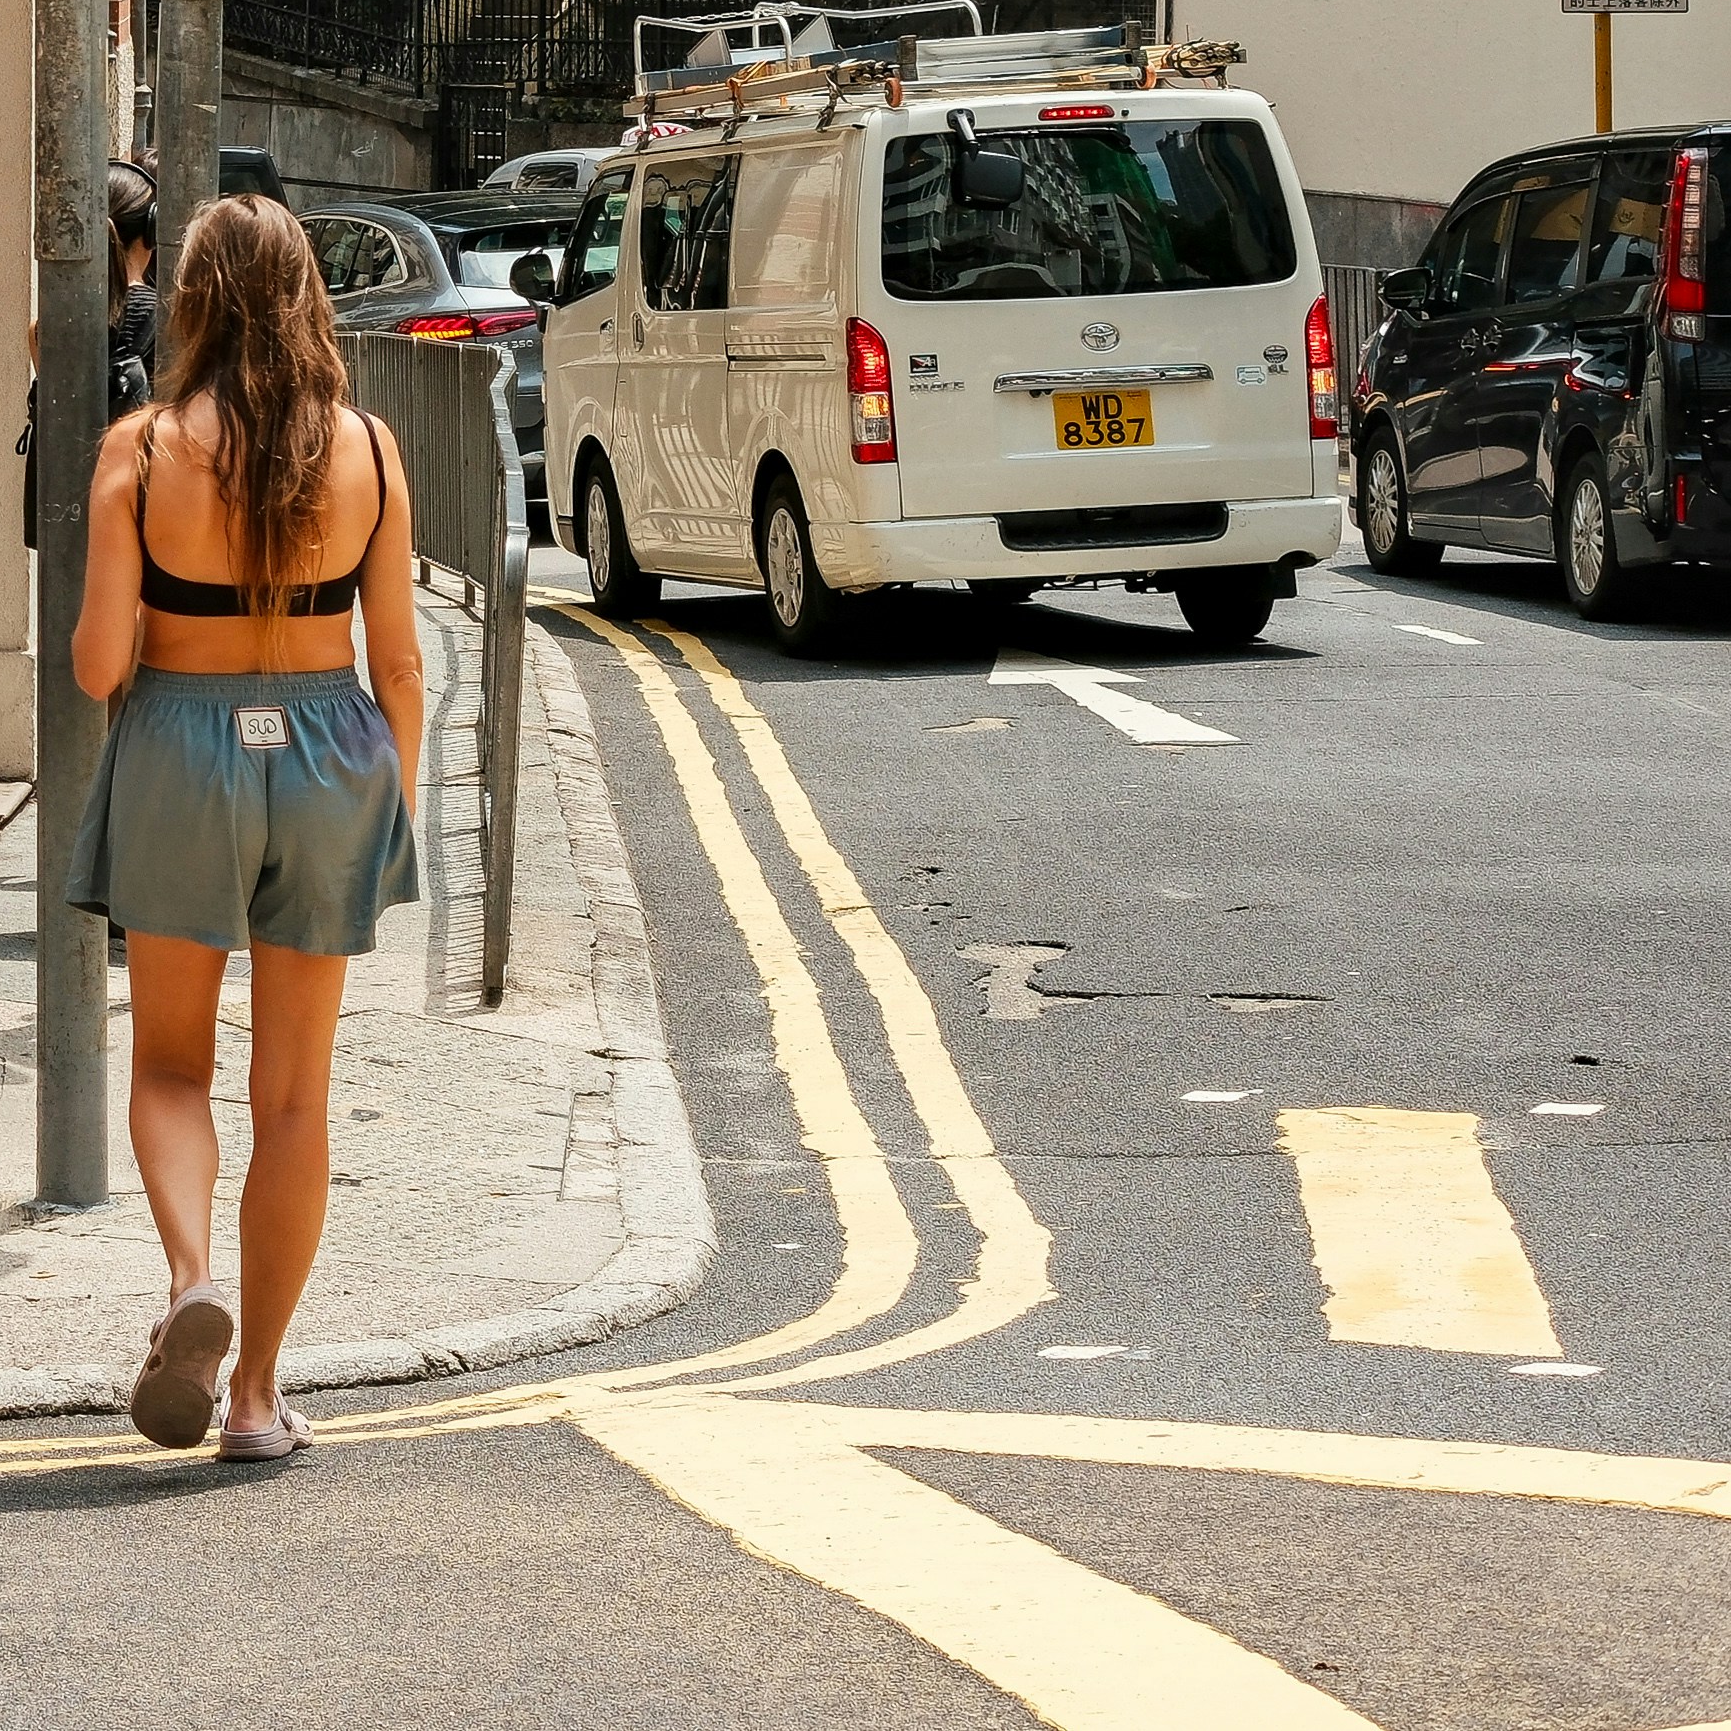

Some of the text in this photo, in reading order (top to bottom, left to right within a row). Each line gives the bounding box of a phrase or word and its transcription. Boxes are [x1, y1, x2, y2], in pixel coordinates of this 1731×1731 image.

[511, 339, 534, 349] 350
[1081, 394, 1123, 420] WD
[1063, 417, 1146, 447] 8387
